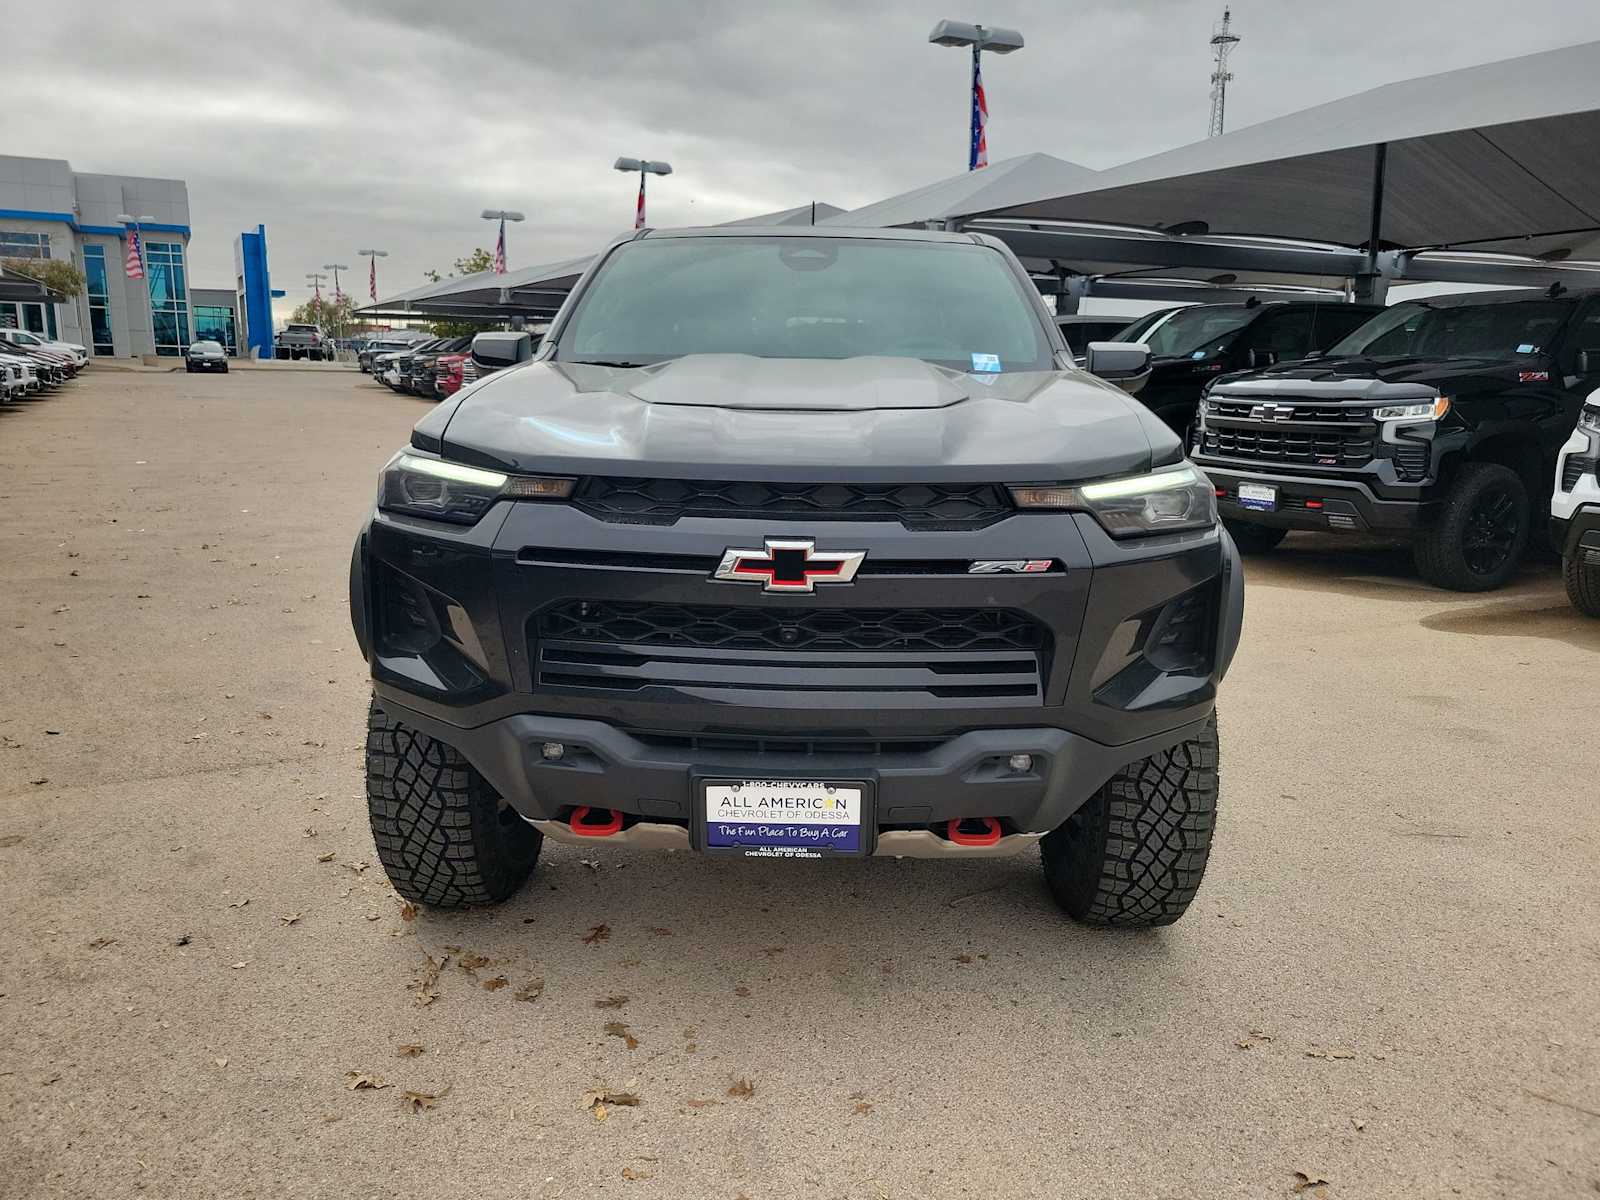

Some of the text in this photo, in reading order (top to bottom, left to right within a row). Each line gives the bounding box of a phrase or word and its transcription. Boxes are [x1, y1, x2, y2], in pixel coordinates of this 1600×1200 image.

[968, 560, 1053, 573] ZR2
[720, 796, 753, 808] ALL
[717, 809, 850, 820] CHEVROLET OF ODESSA
[718, 825, 849, 841] The Fun Place To Buy A Car
